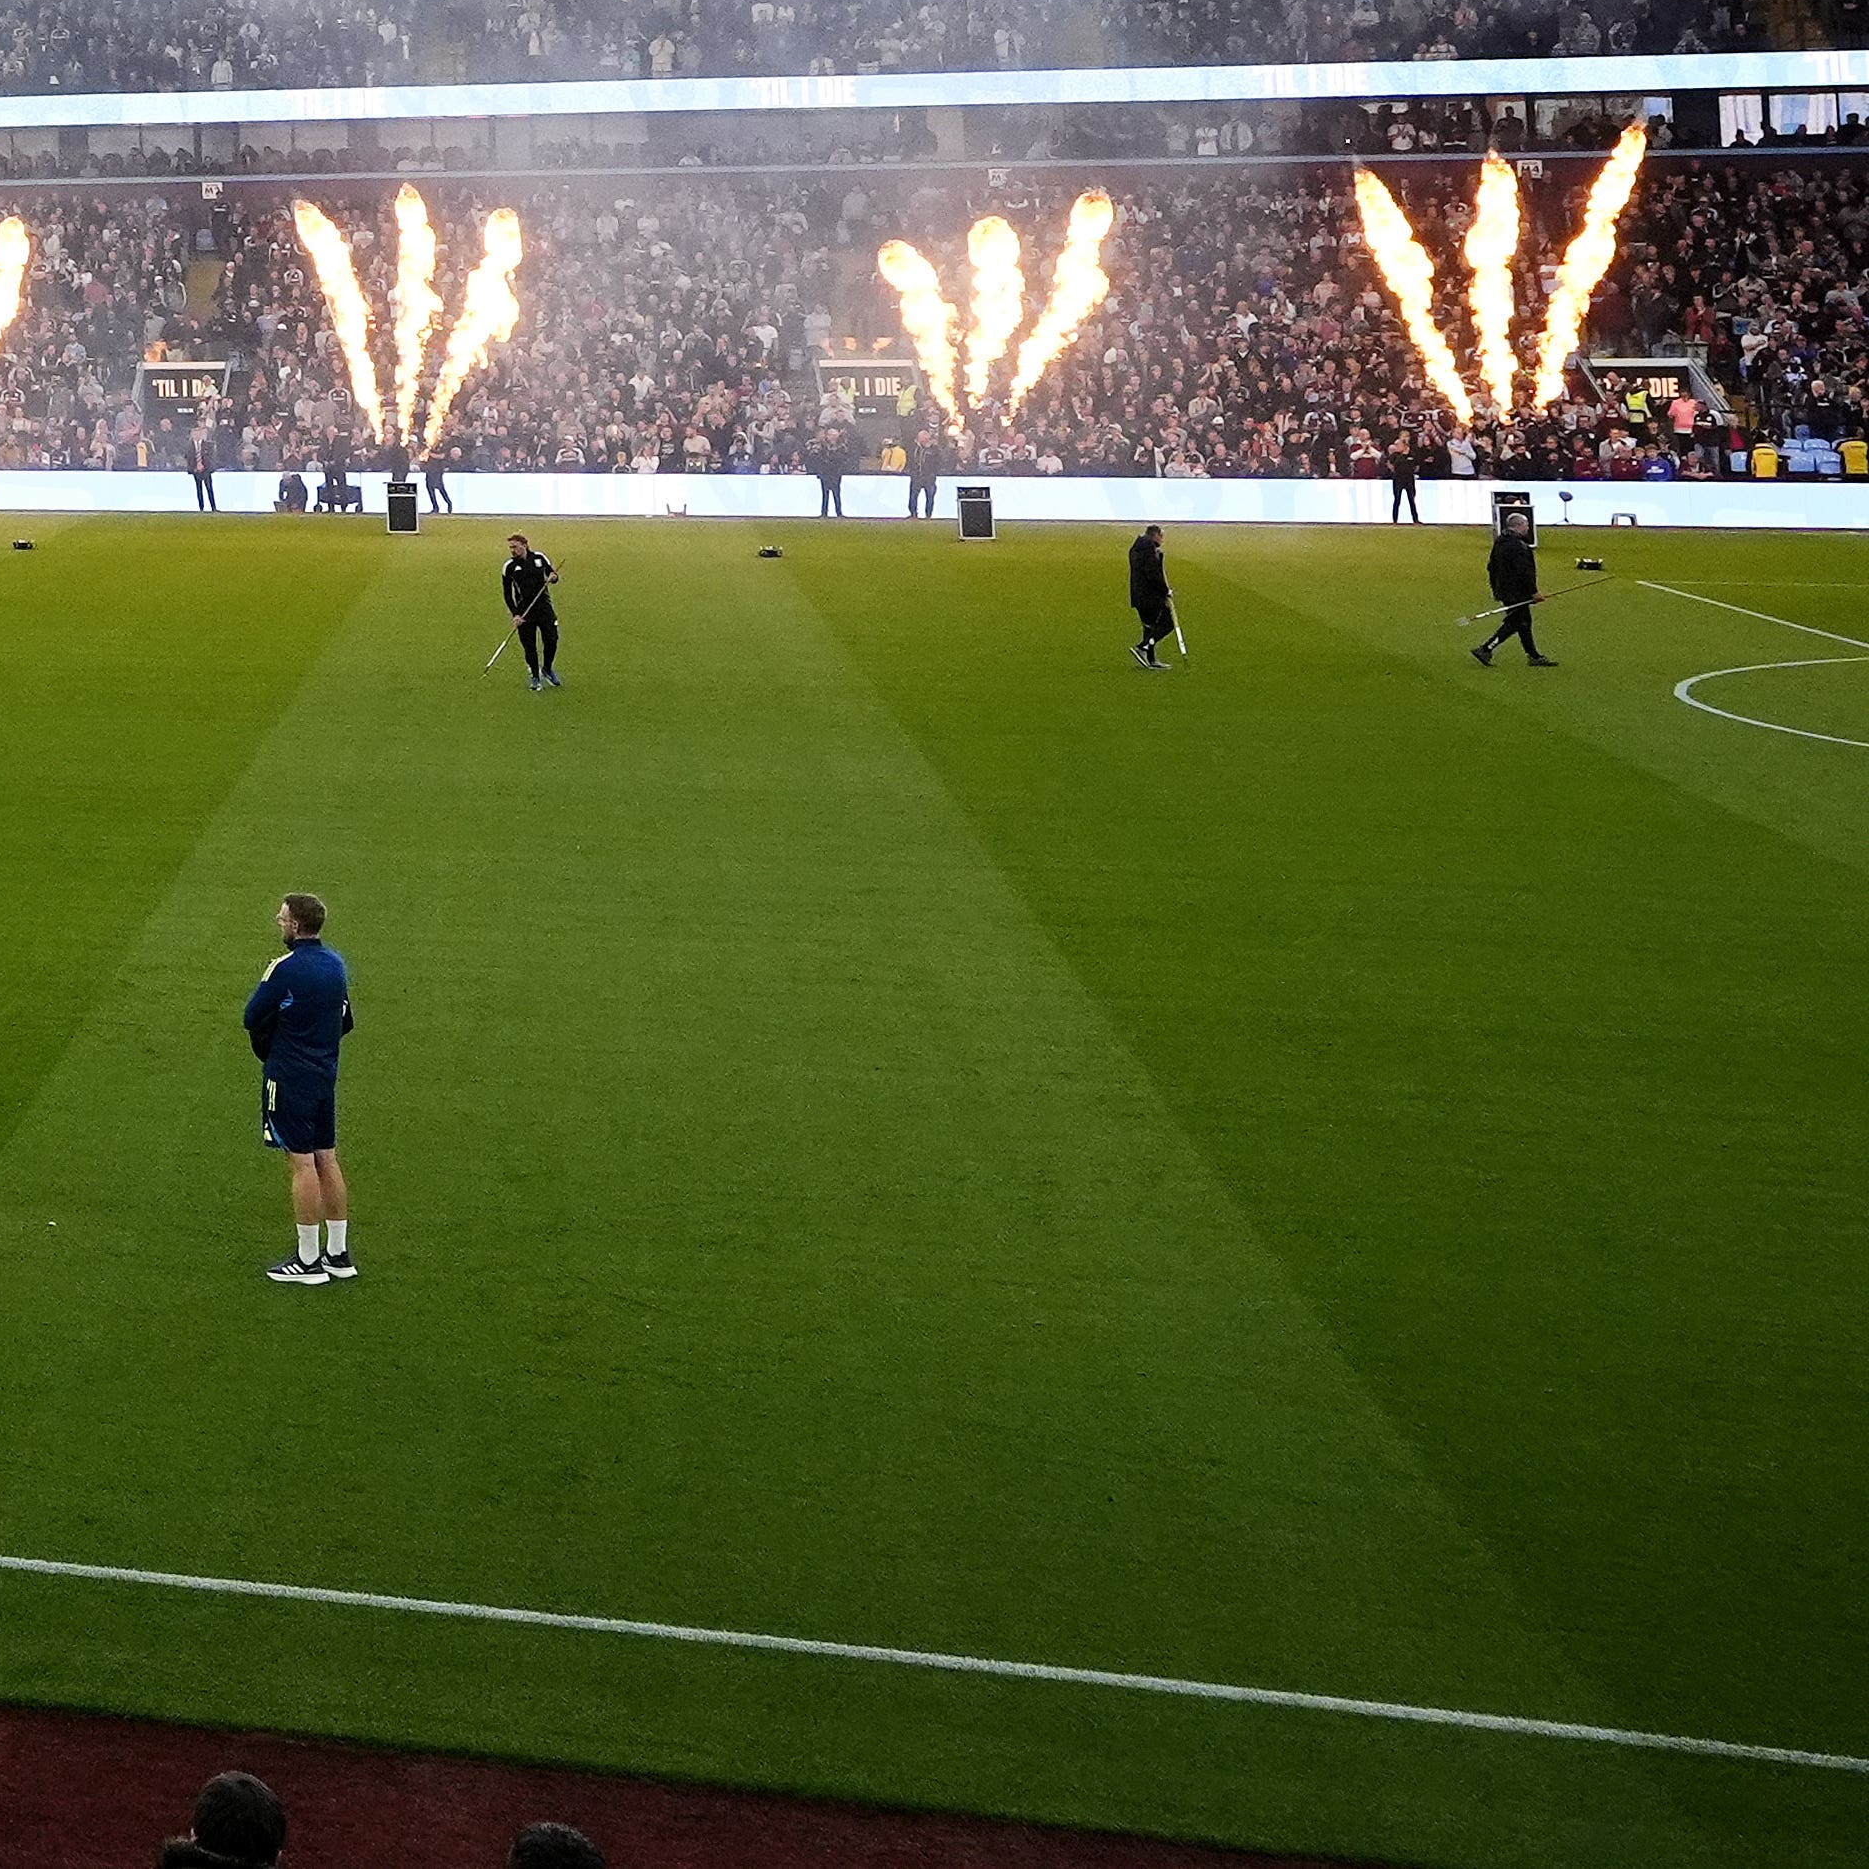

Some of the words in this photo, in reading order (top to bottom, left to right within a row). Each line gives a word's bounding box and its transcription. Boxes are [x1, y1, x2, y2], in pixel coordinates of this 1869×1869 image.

[1327, 65, 1368, 96] DIE
[818, 76, 858, 107] DIE
[182, 379, 188, 397] I
[875, 377, 902, 397] DIE
[1649, 377, 1680, 398] DIE
